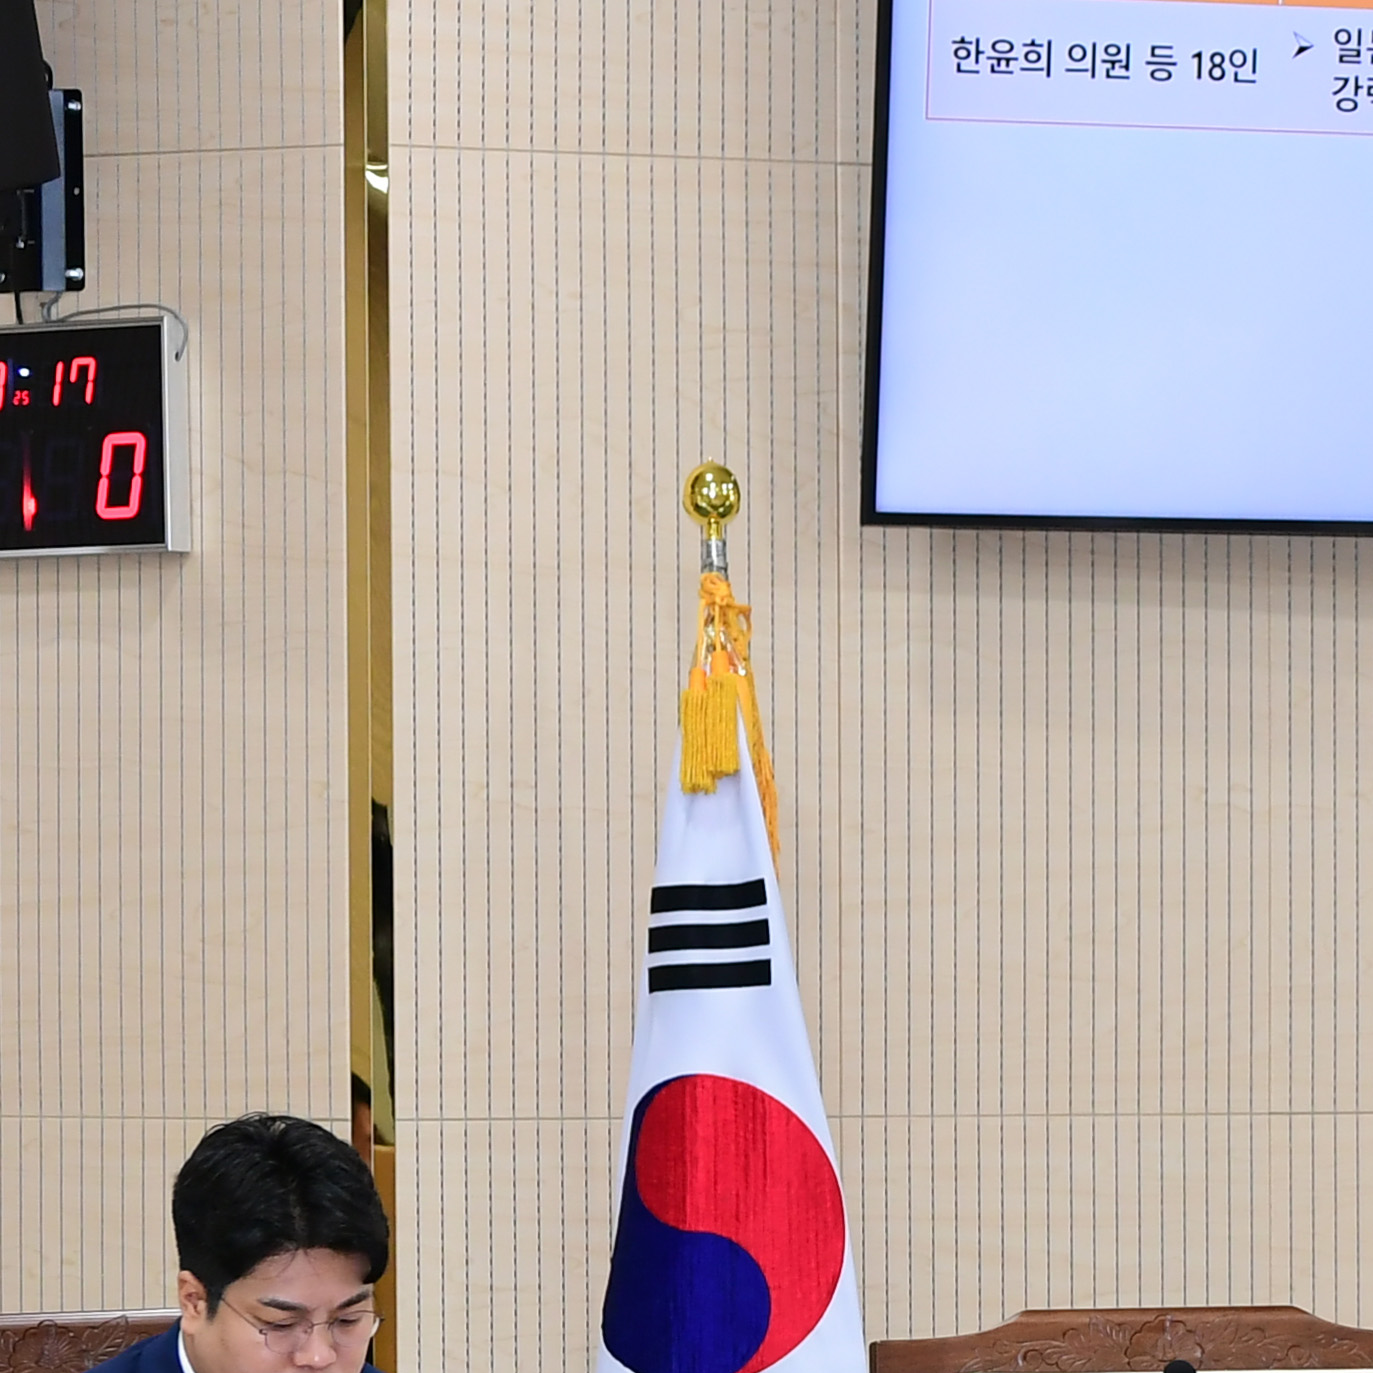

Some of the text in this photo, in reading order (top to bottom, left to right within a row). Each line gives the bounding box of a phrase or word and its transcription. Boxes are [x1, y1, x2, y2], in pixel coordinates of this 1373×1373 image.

[951, 36, 1257, 84] 한윤희 의원 등 18인
[94, 430, 148, 521] 0
